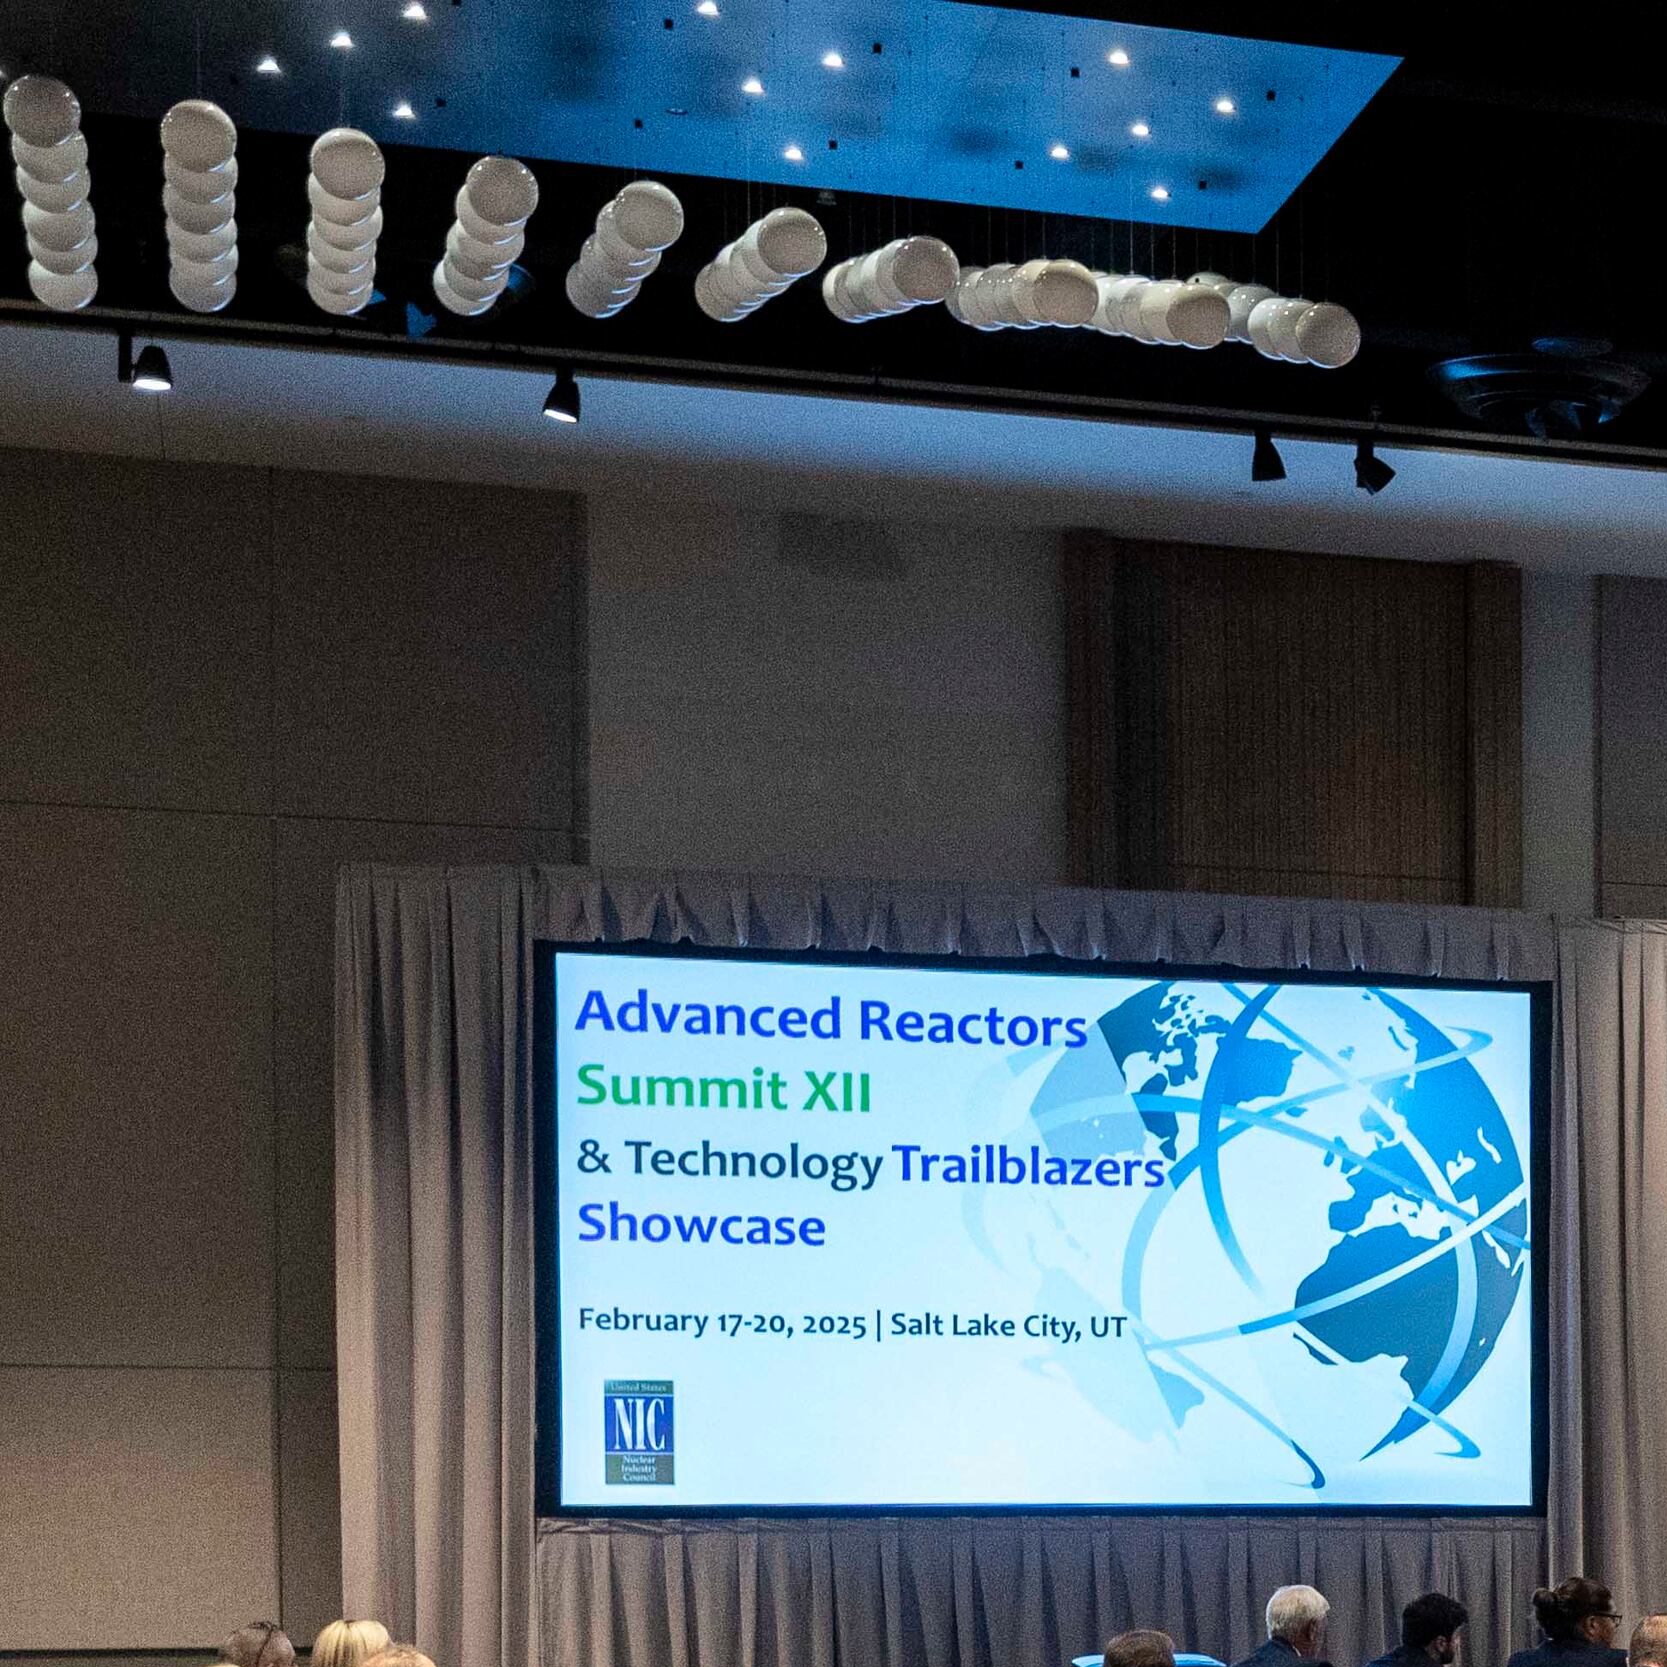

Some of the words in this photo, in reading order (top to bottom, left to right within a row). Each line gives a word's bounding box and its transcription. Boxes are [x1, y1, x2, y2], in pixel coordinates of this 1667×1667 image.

[575, 988, 841, 1043] Advanced
[860, 999, 1089, 1049] Reactors
[576, 1063, 788, 1111] Summit
[802, 1071, 872, 1113] XII
[576, 1138, 612, 1174] &
[624, 1139, 884, 1193] Technology
[891, 1144, 1165, 1189] Trailblazers
[578, 1200, 827, 1247] Showcase
[579, 1306, 709, 1338] February
[717, 1313, 794, 1340] 17-20,
[803, 1315, 867, 1340] 2025
[890, 1311, 945, 1337] Salt
[952, 1312, 1016, 1337] Lake
[1023, 1313, 1082, 1345] City,
[1091, 1315, 1128, 1339] UT
[613, 1398, 666, 1451] NIC
